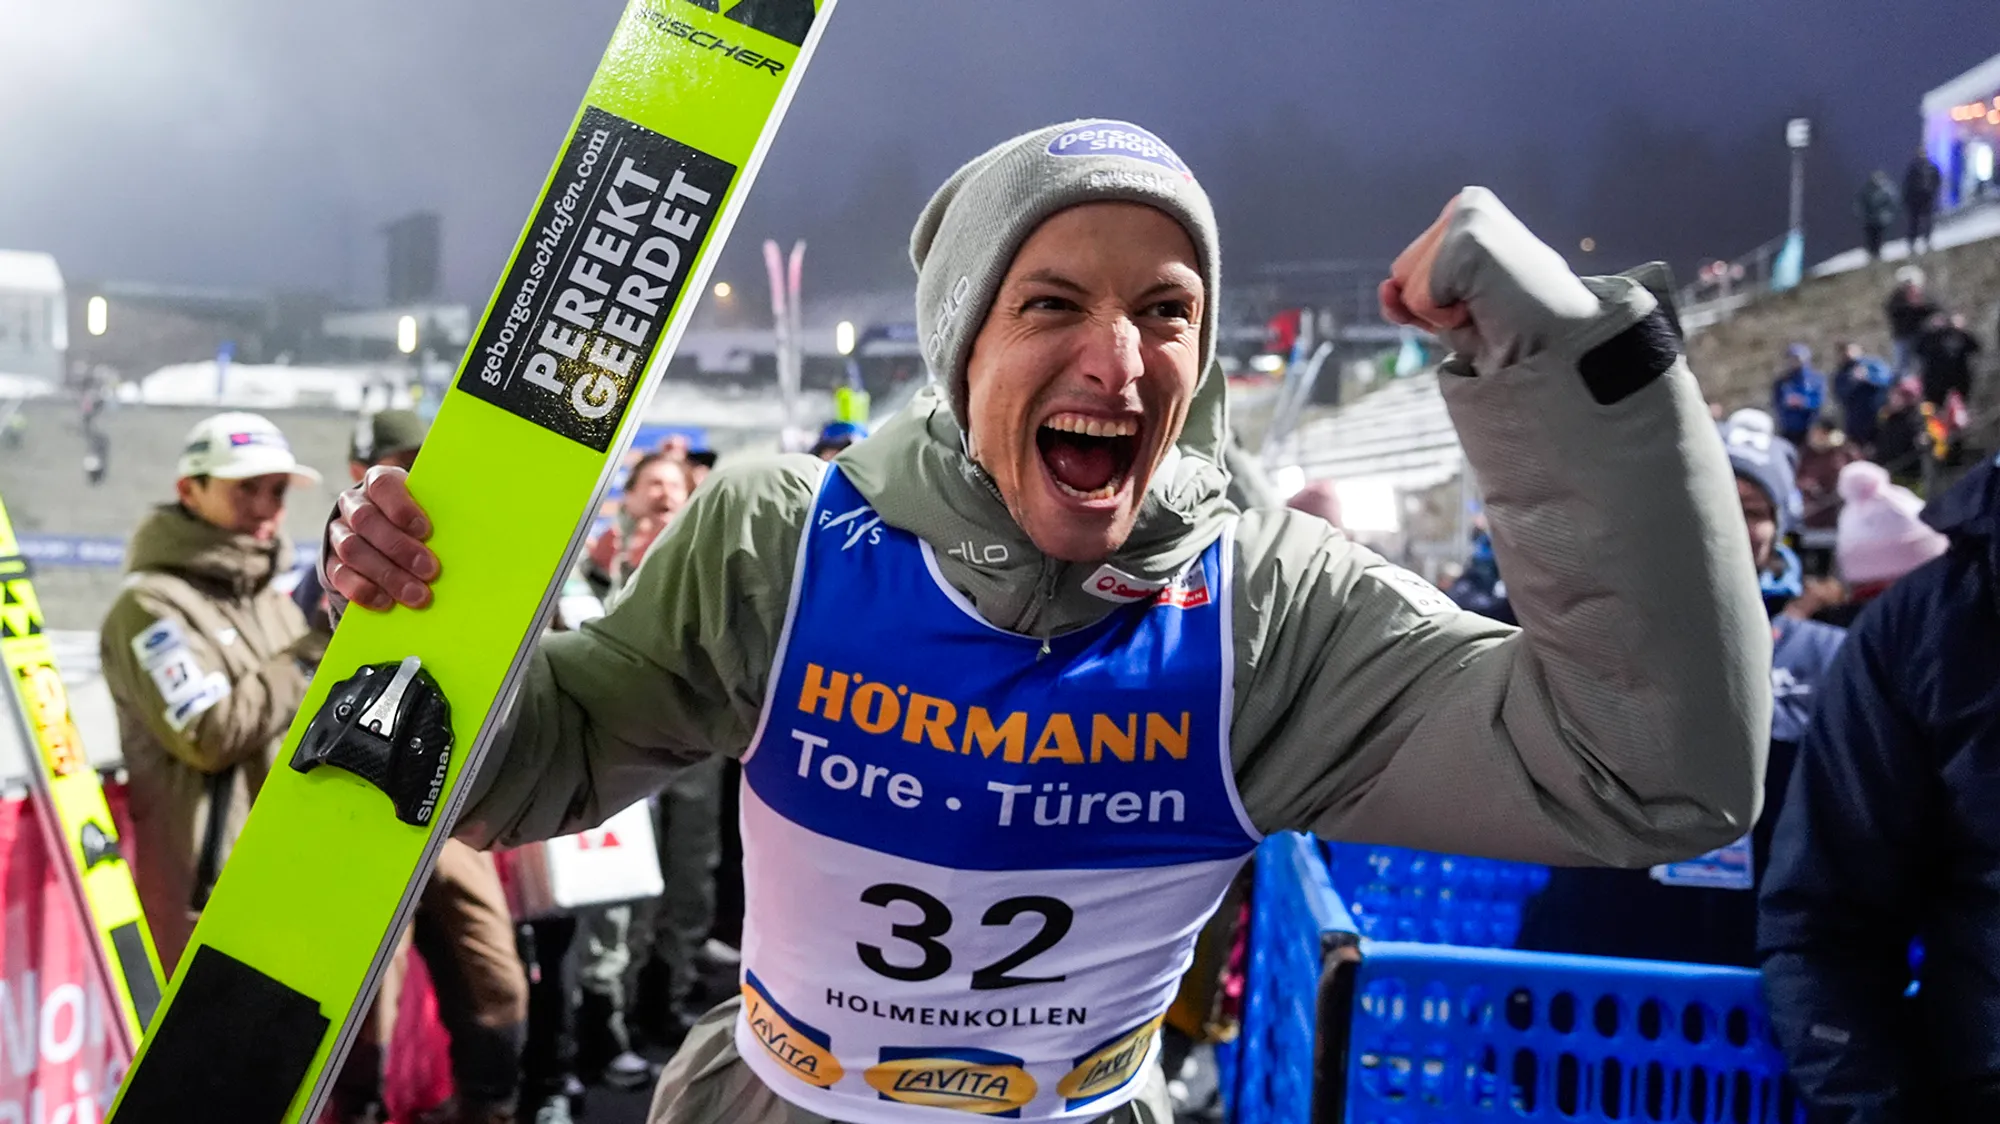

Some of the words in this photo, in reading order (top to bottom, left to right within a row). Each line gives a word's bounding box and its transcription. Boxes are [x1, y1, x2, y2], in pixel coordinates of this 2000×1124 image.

[1089, 136, 1159, 158] shop
[480, 128, 609, 387] geborgenschlafen.com
[522, 157, 661, 396] PERFEKT
[571, 170, 712, 420] GEERDET
[818, 508, 883, 546] FIS
[797, 662, 1191, 766] HÖRMANN
[790, 728, 924, 810] Tore
[986, 781, 1187, 827] Türen
[855, 882, 1075, 992] 32
[751, 1001, 821, 1080] LAVITA
[825, 987, 1088, 1028] HOLMENKOLLEN
[892, 1068, 1012, 1103] LAVITA
